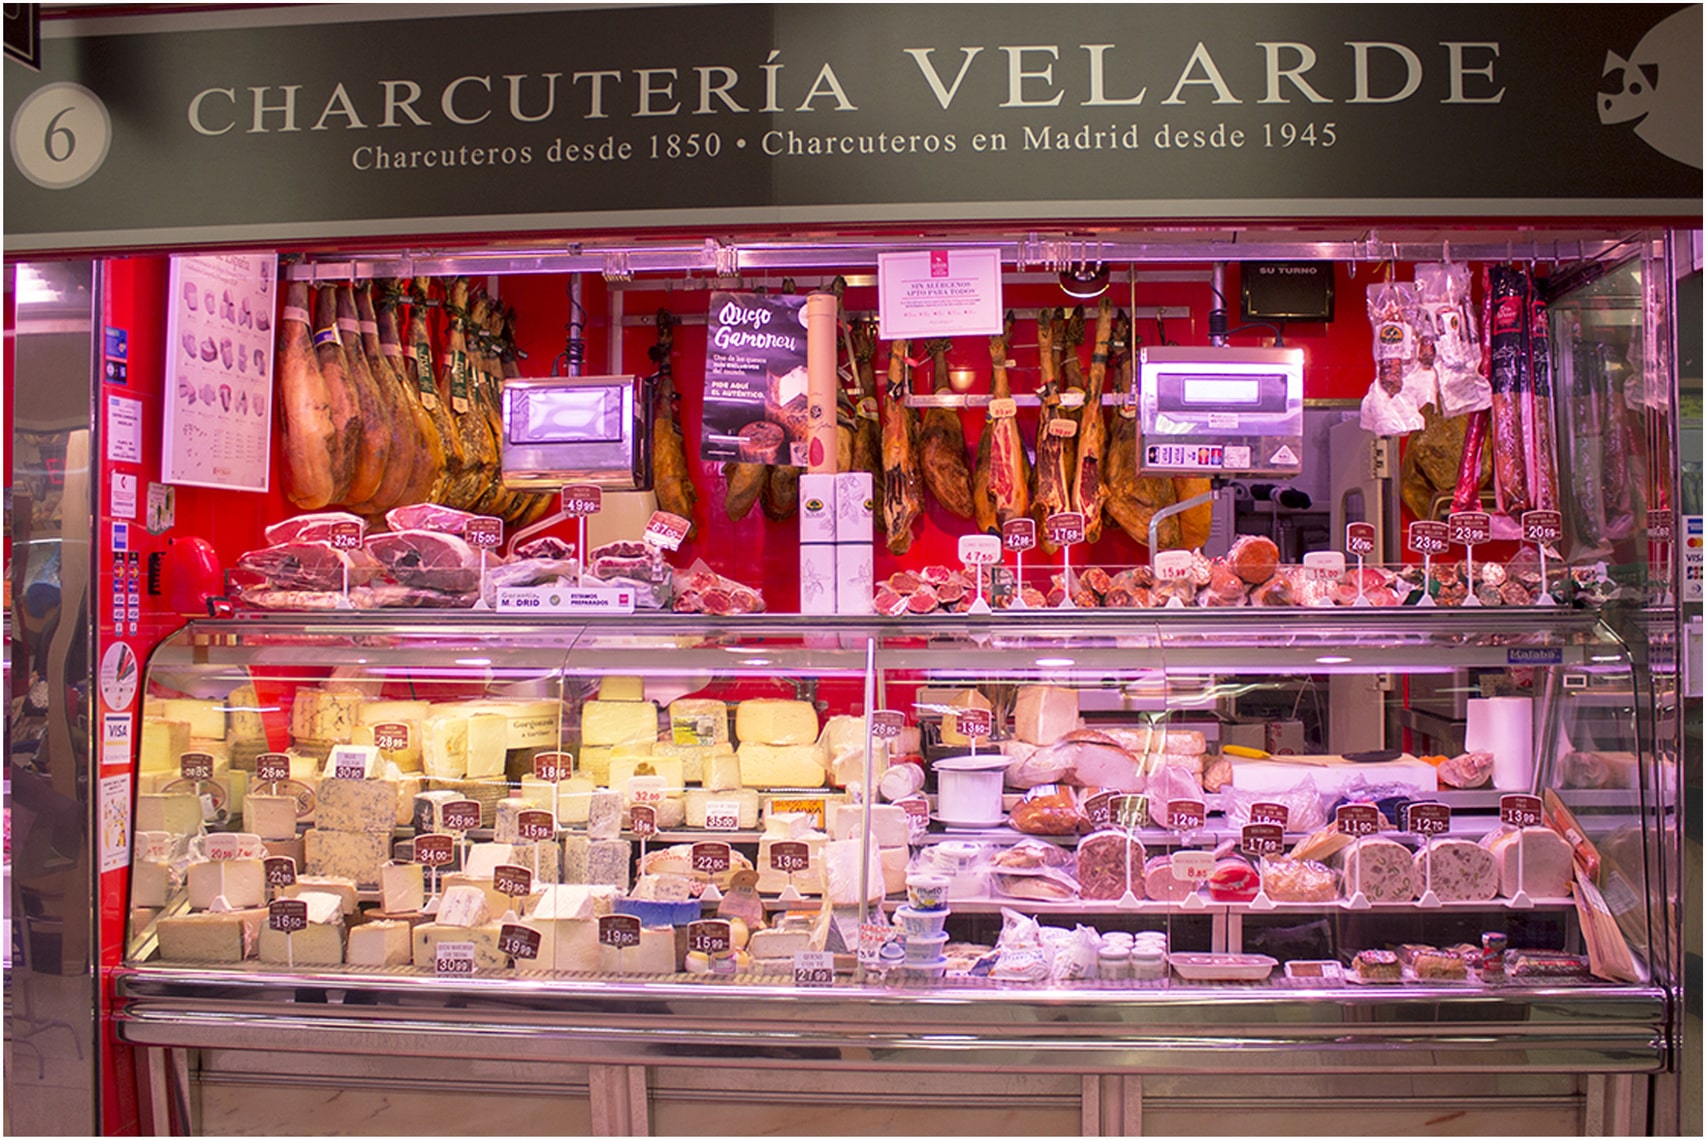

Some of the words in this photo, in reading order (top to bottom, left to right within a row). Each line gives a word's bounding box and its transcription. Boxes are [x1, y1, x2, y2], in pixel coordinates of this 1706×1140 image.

[188, 49, 860, 136] CHARCUTERÍA
[903, 40, 1507, 110] VELARDE
[44, 106, 76, 162] 6
[352, 146, 516, 171] Charcuteros
[546, 139, 632, 163] desde
[647, 133, 723, 160] 1850
[761, 130, 957, 156] Charcuteros
[972, 133, 1008, 152] en
[1022, 123, 1140, 152] Madrid
[1154, 123, 1246, 150] desde
[1263, 122, 1338, 149] 1945
[1259, 266, 1276, 275] SU
[1278, 266, 1318, 275] TURNO
[718, 301, 769, 329] Queso
[711, 381, 729, 389] PIDE
[108, 724, 128, 738] VISA
